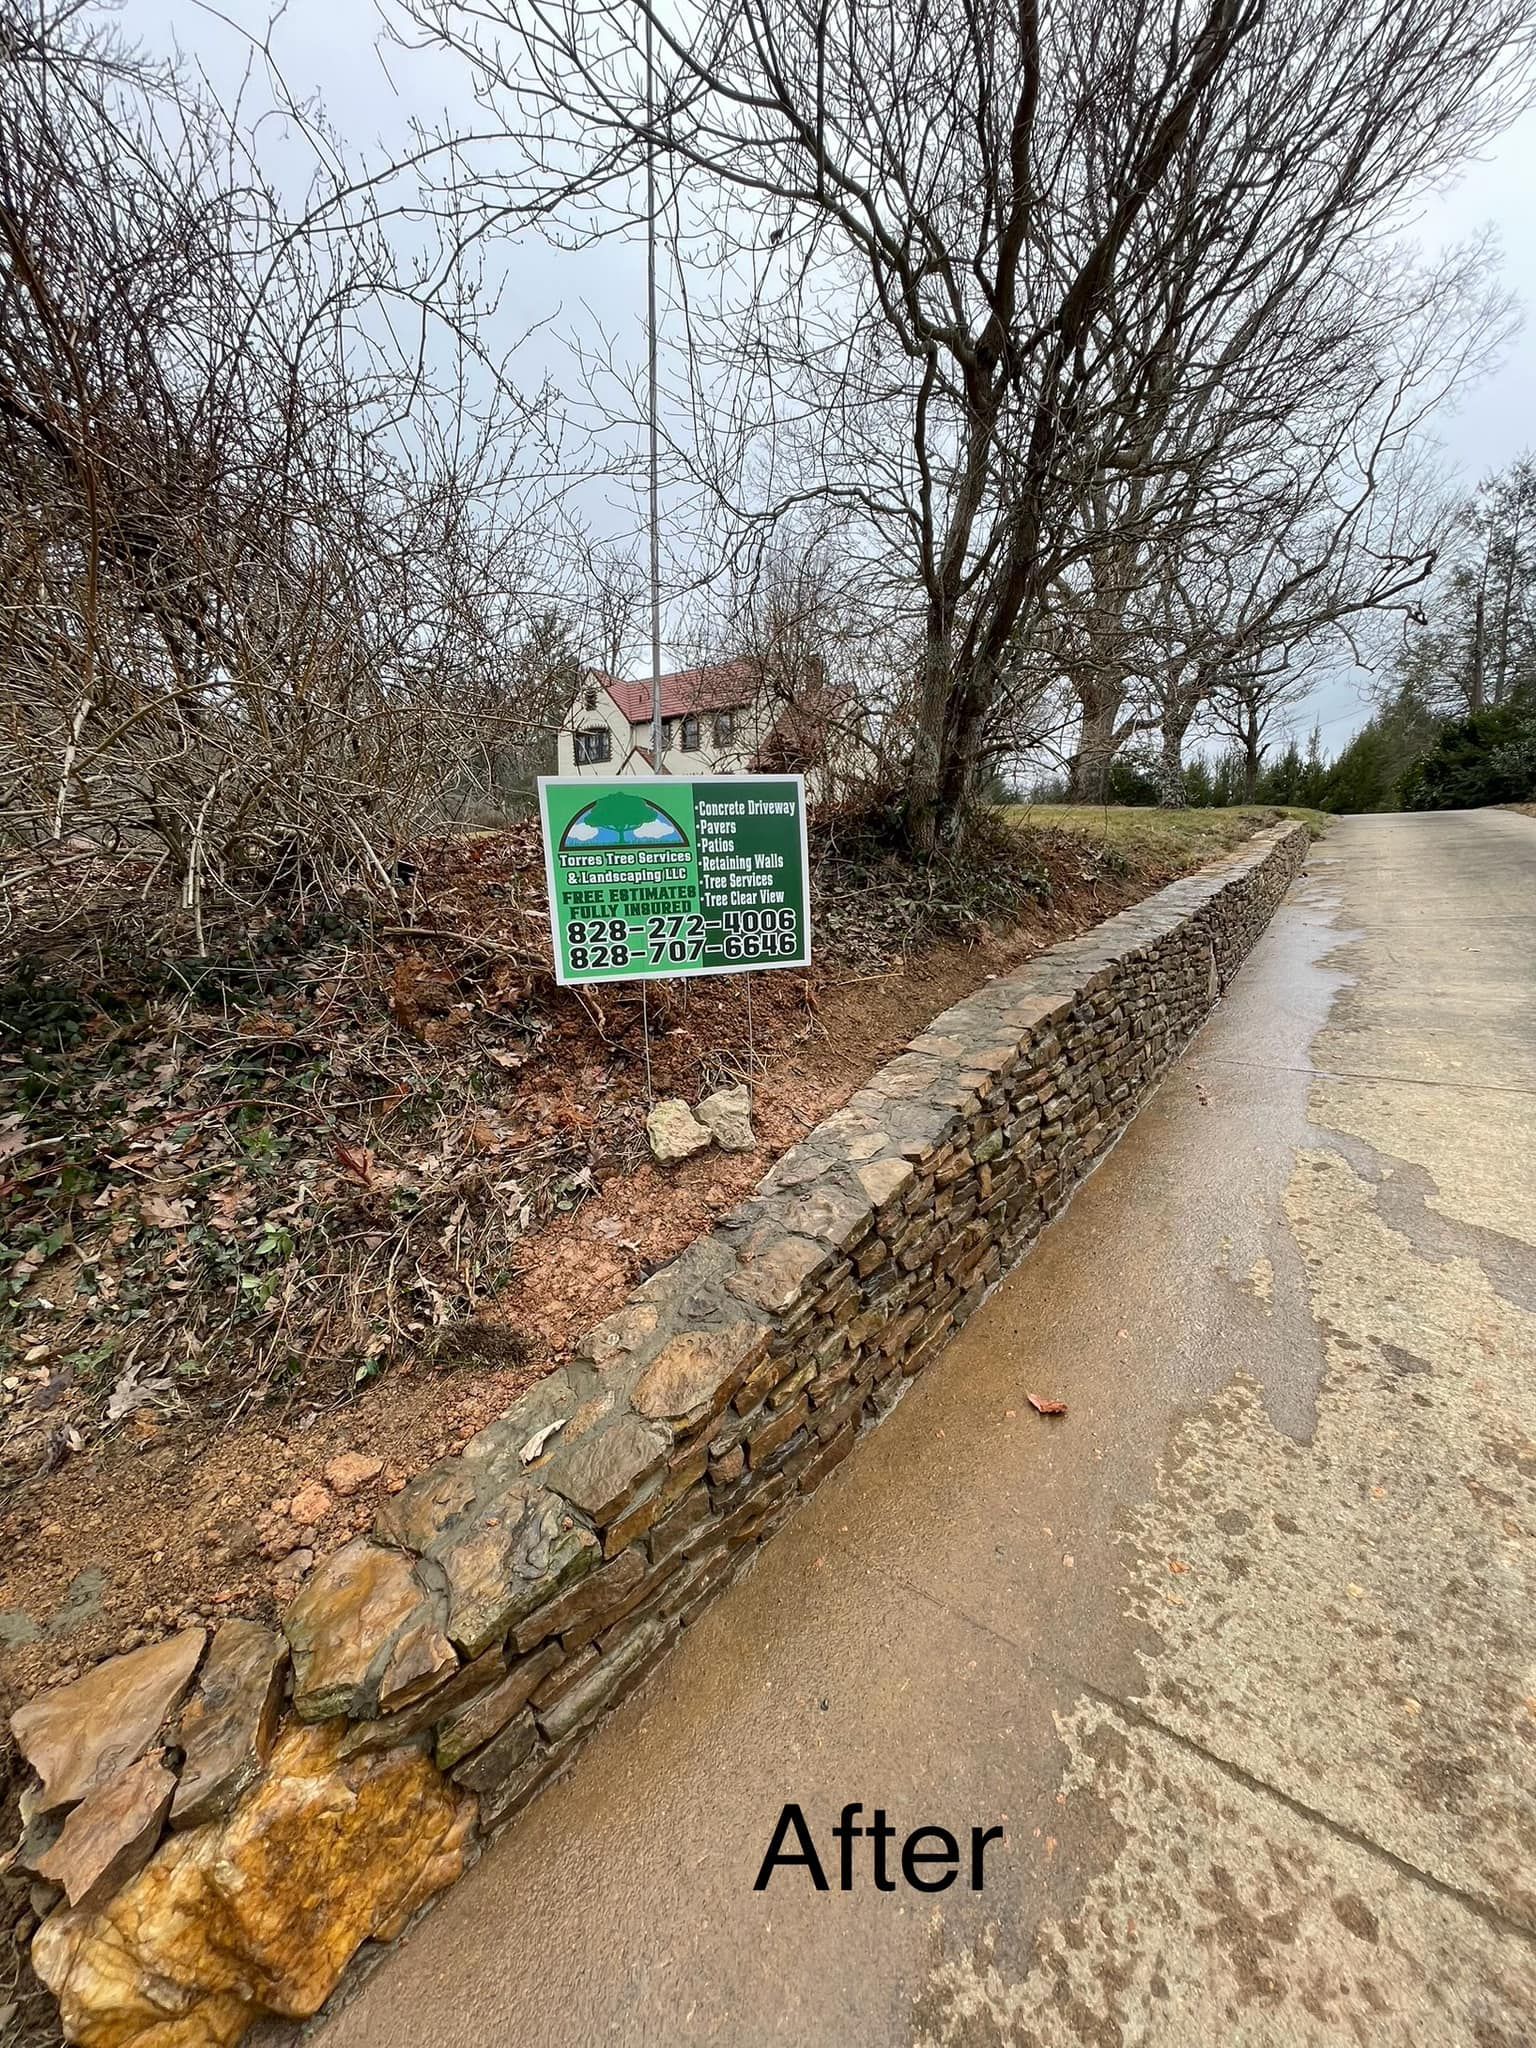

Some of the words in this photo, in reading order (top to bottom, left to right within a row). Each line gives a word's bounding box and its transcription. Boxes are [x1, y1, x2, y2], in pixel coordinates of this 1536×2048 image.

[699, 801, 745, 816] Concrete
[748, 800, 795, 816] Driveway
[701, 821, 736, 834] Pavers
[702, 839, 735, 852] Patios
[560, 854, 602, 867] Torres
[606, 853, 635, 865] Tree
[639, 852, 691, 864] Services
[703, 855, 752, 871] Retaining
[754, 854, 784, 868] Walls
[568, 872, 579, 884] &
[582, 870, 661, 884] Landscaping
[665, 867, 686, 880] LLC
[704, 875, 727, 889] Tree
[730, 873, 773, 887] Services
[562, 890, 603, 904] FREE
[704, 893, 728, 906] Tree
[731, 891, 757, 905] Clear
[760, 890, 784, 903] View
[570, 904, 618, 920] FULLY
[624, 901, 691, 917] INSURED
[567, 909, 796, 945] 828-272-4006
[569, 933, 796, 970] 828-707-6646
